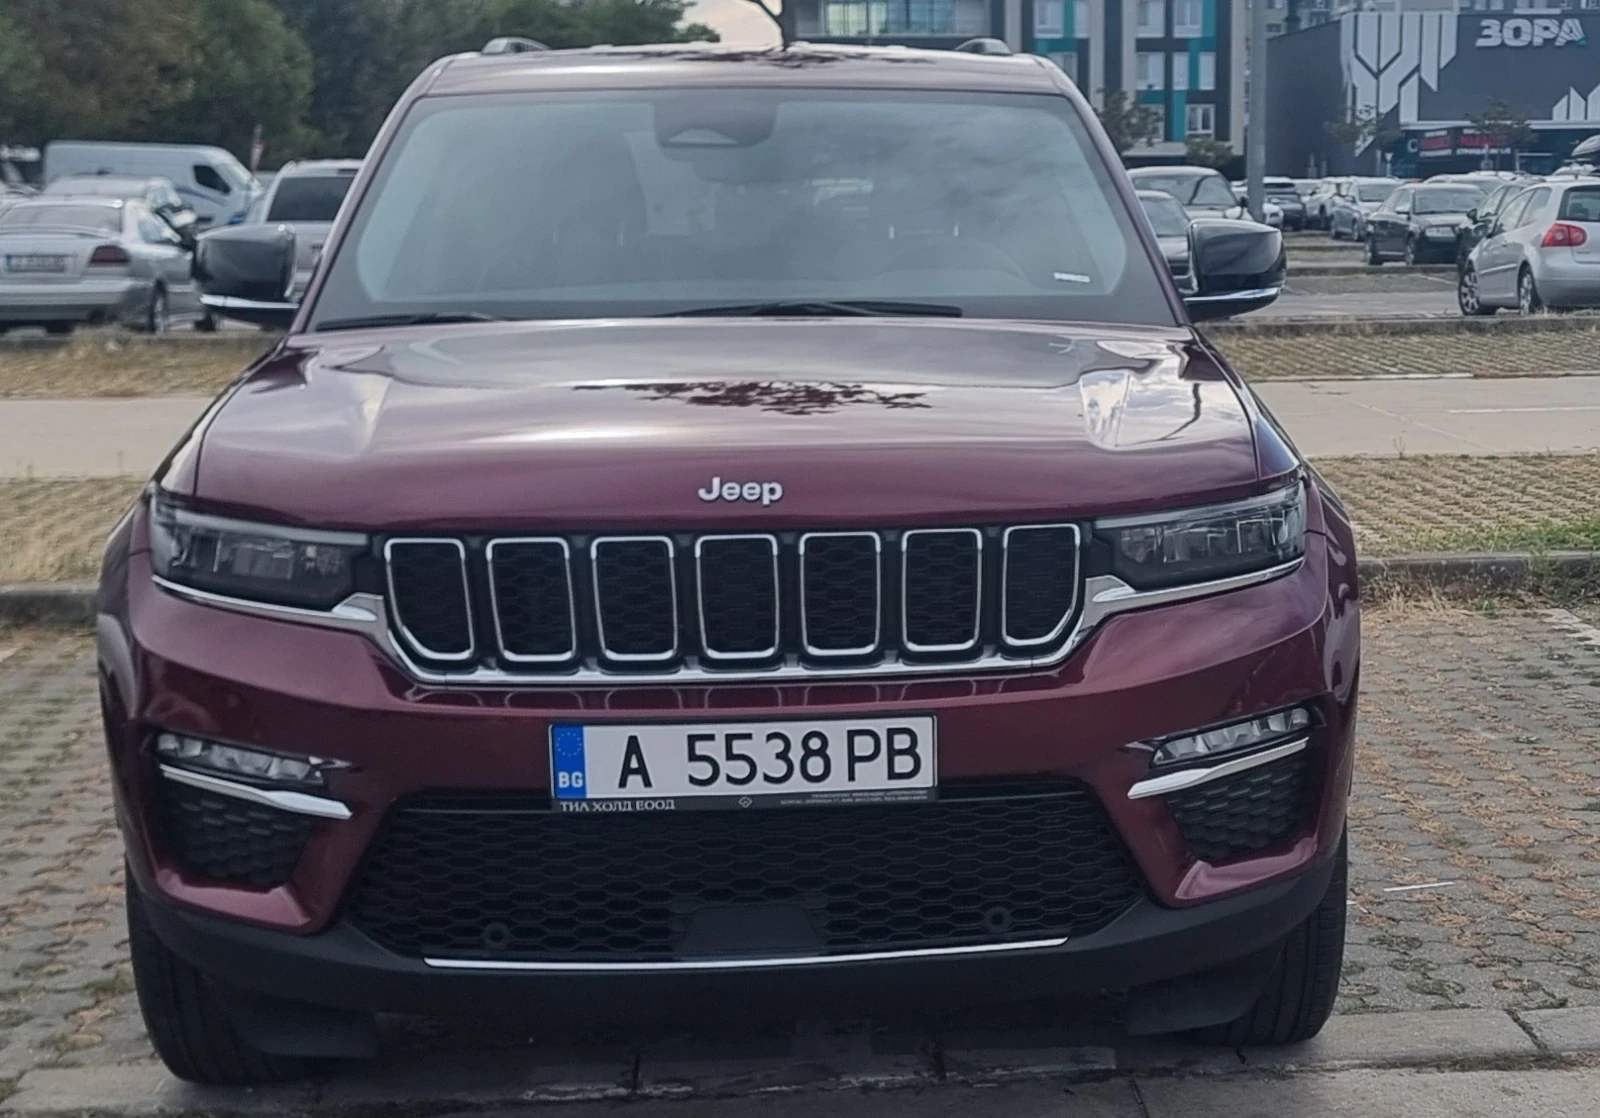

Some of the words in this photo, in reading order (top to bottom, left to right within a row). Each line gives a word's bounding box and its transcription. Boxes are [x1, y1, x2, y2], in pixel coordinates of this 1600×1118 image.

[1475, 18, 1586, 46] ЗОРА
[698, 476, 783, 505] Jeep
[618, 735, 653, 787] A
[687, 730, 831, 786] 5538
[846, 727, 922, 782] PB
[558, 771, 584, 788] BG
